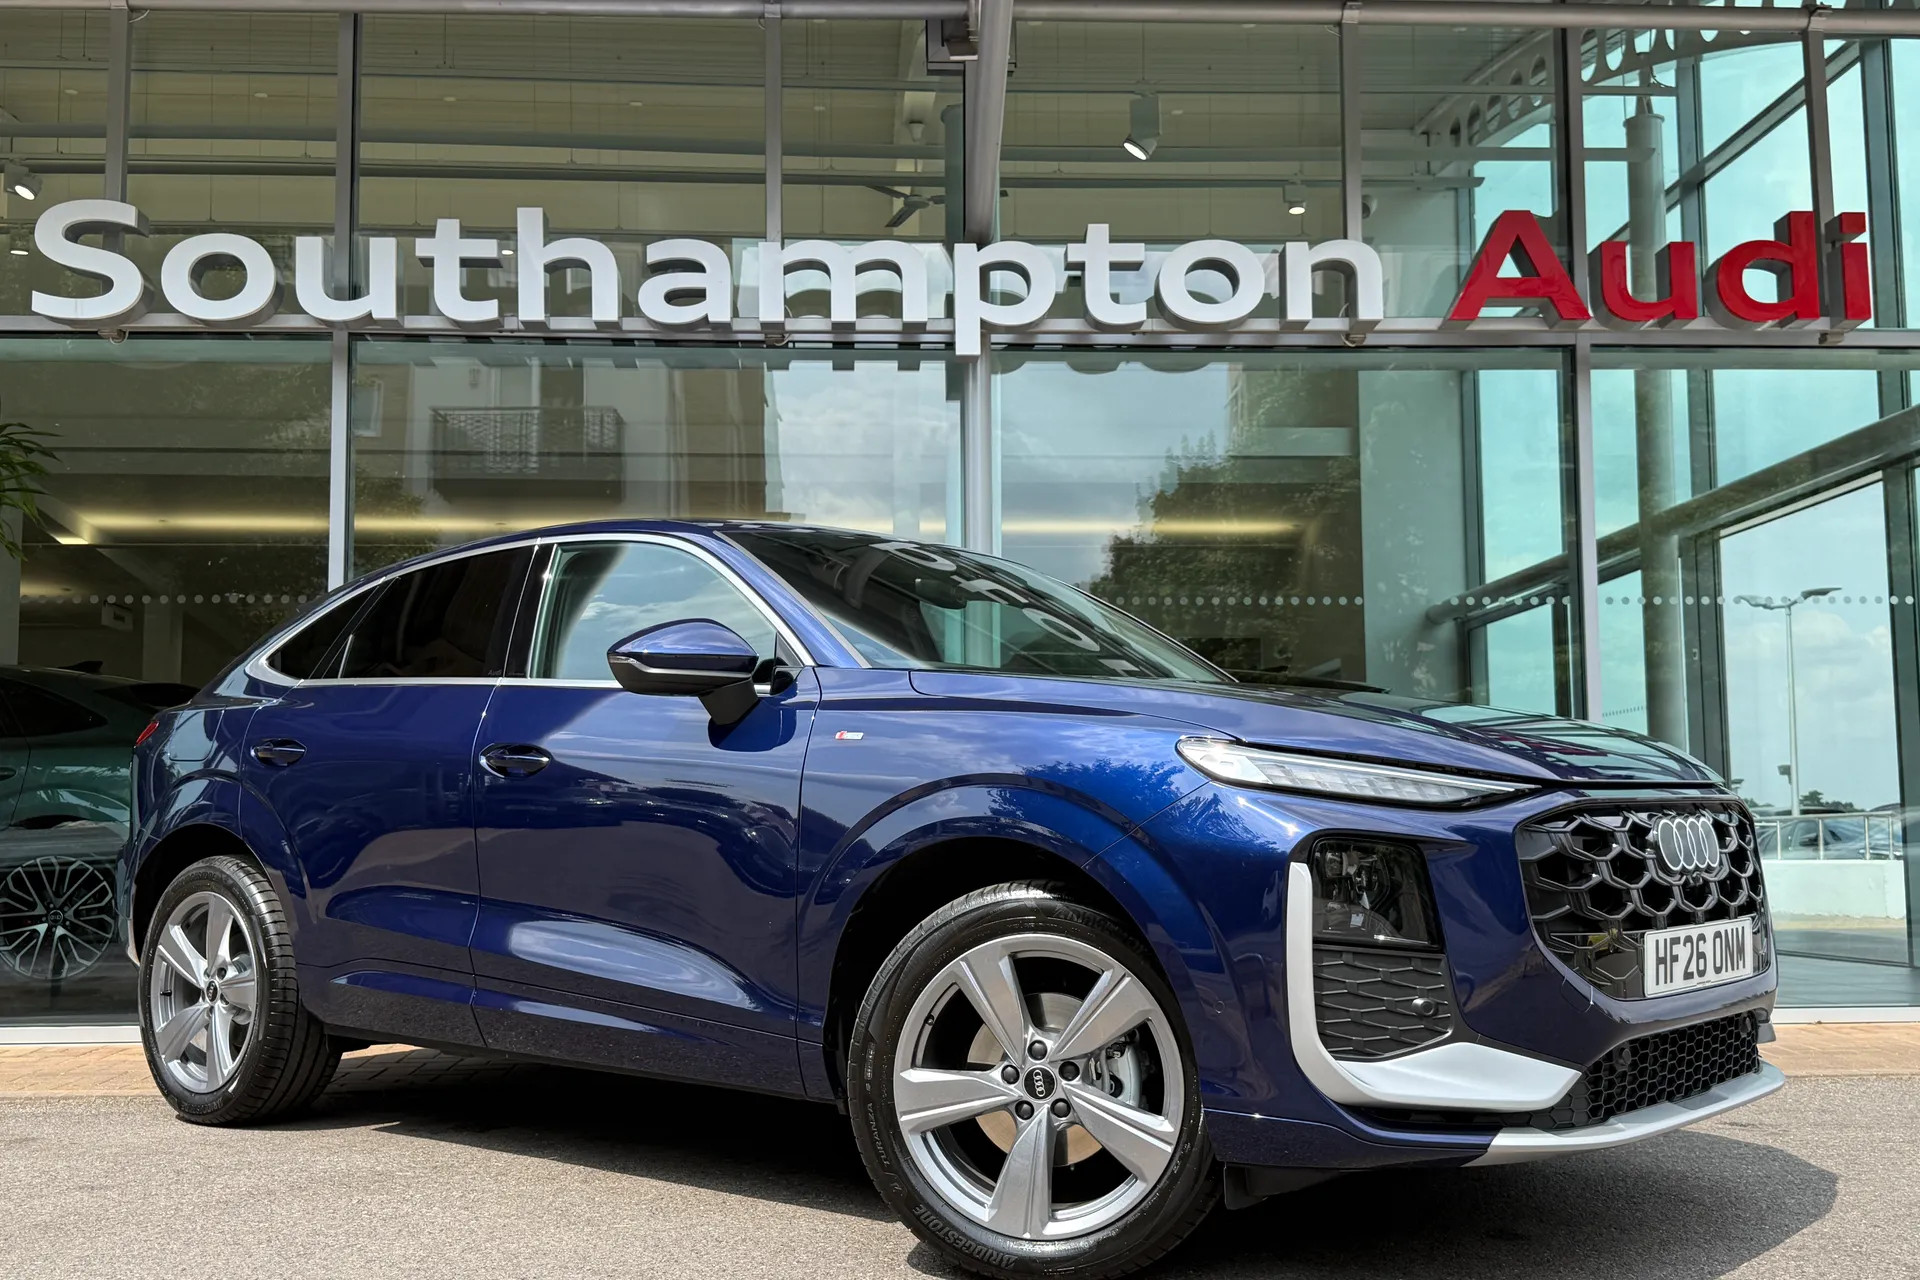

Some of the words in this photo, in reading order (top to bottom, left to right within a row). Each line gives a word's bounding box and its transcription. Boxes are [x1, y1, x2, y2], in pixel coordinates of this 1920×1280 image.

[29, 198, 1385, 357] Southampton
[1444, 209, 1871, 328] Audi
[1655, 933, 1707, 986] HF26
[1712, 926, 1746, 975] ONM
[867, 1102, 890, 1168] TURANZA
[912, 1204, 1019, 1270] BRIDGESTONE
